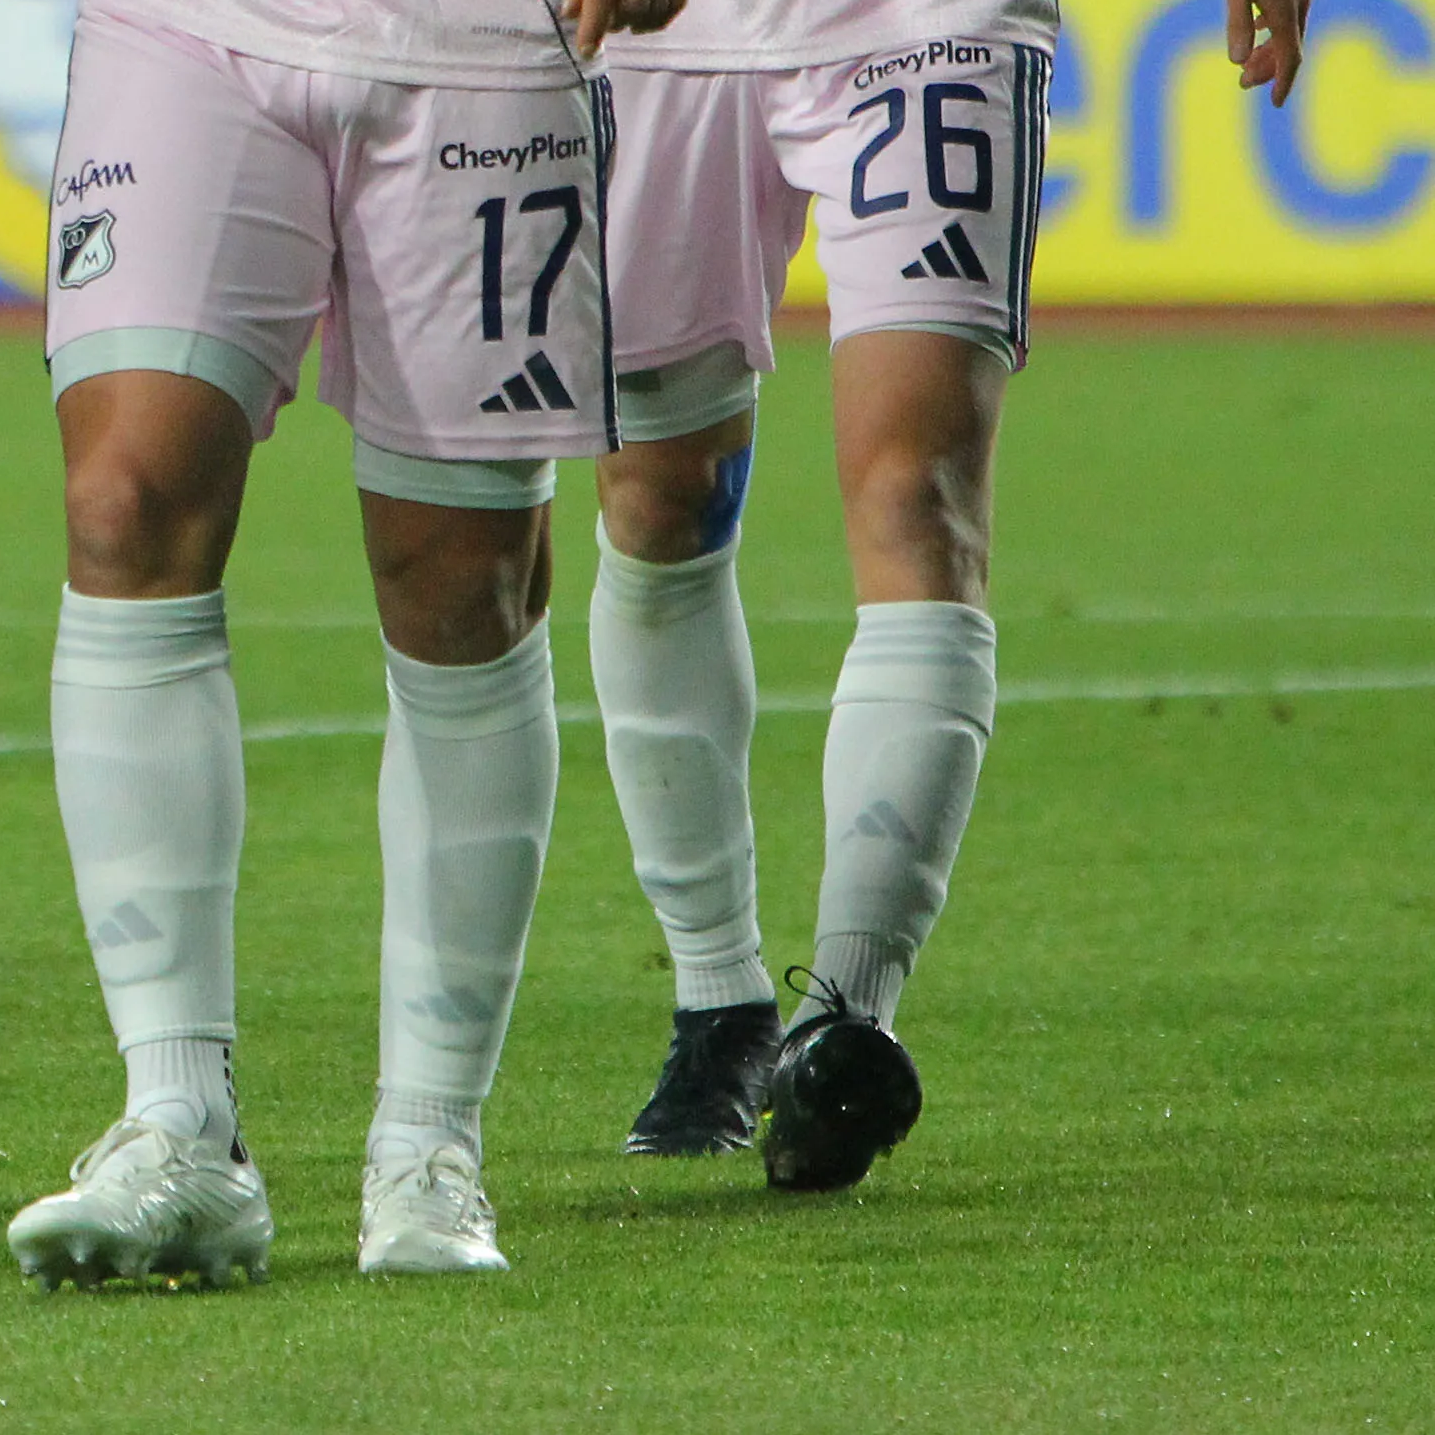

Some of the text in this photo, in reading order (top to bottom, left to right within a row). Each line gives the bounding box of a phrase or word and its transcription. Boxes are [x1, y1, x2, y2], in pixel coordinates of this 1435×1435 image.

[853, 39, 993, 91] ChevyPlan
[439, 132, 588, 173] ChevyPlan
[847, 82, 993, 221] 26
[475, 184, 583, 342] 17
